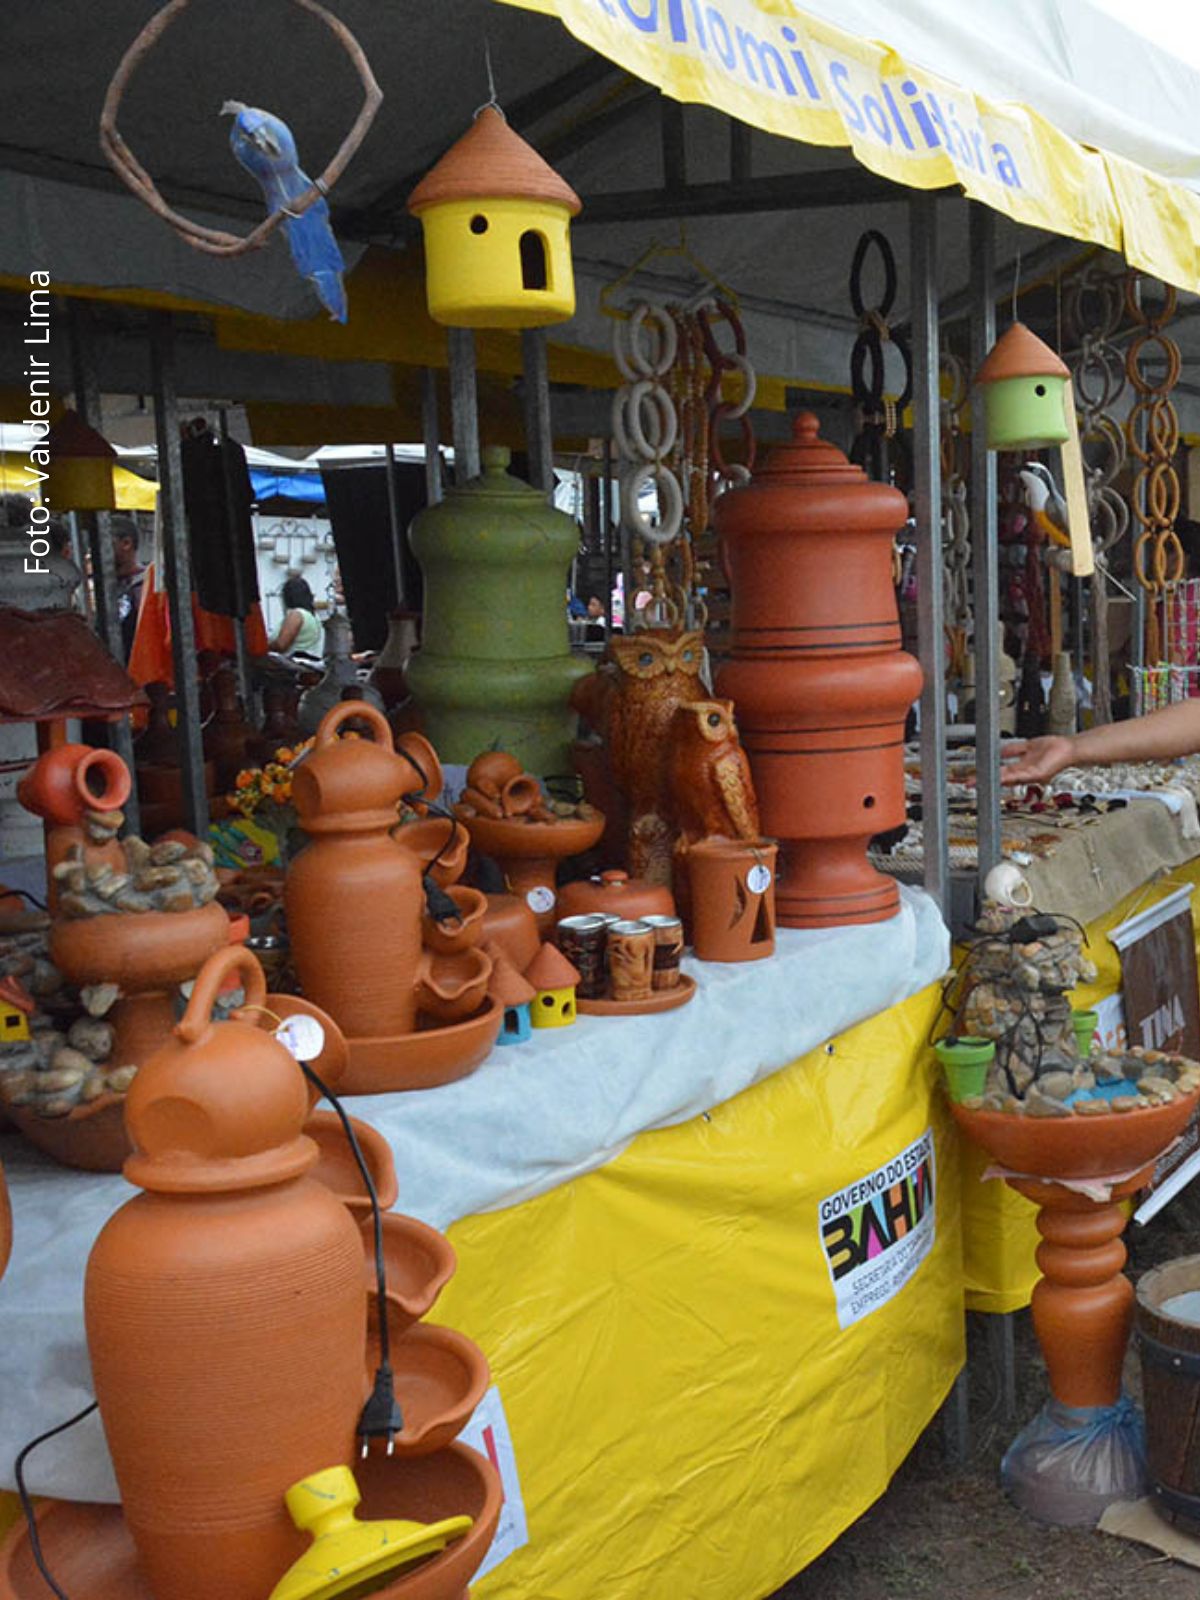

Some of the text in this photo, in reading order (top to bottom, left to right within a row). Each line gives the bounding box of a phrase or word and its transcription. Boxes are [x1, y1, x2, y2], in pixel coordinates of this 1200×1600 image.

[821, 1171, 885, 1220] GOVERNO
[886, 1159, 903, 1184] DO
[822, 1157, 933, 1282] BAHIA
